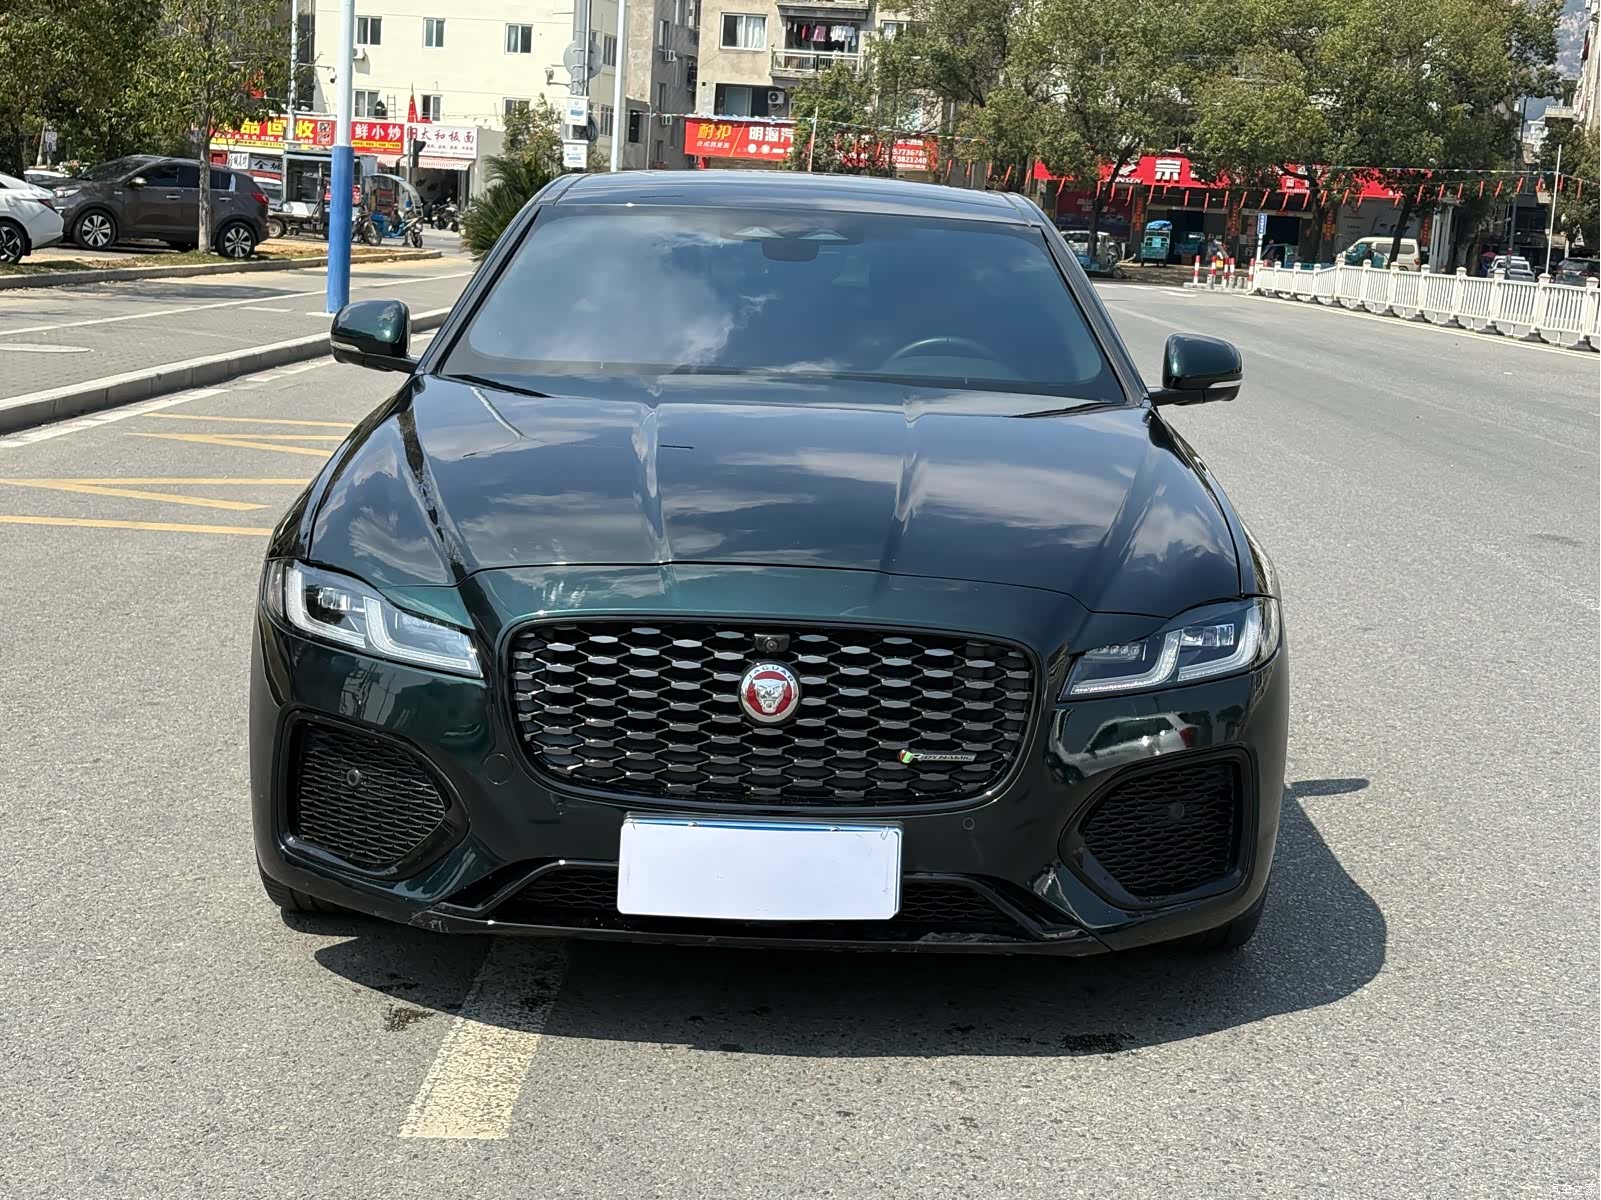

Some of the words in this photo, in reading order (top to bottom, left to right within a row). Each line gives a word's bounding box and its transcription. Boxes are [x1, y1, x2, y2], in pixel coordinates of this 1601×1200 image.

[355, 124, 401, 141] 鲜小炒
[748, 665, 794, 682] JAGUAR
